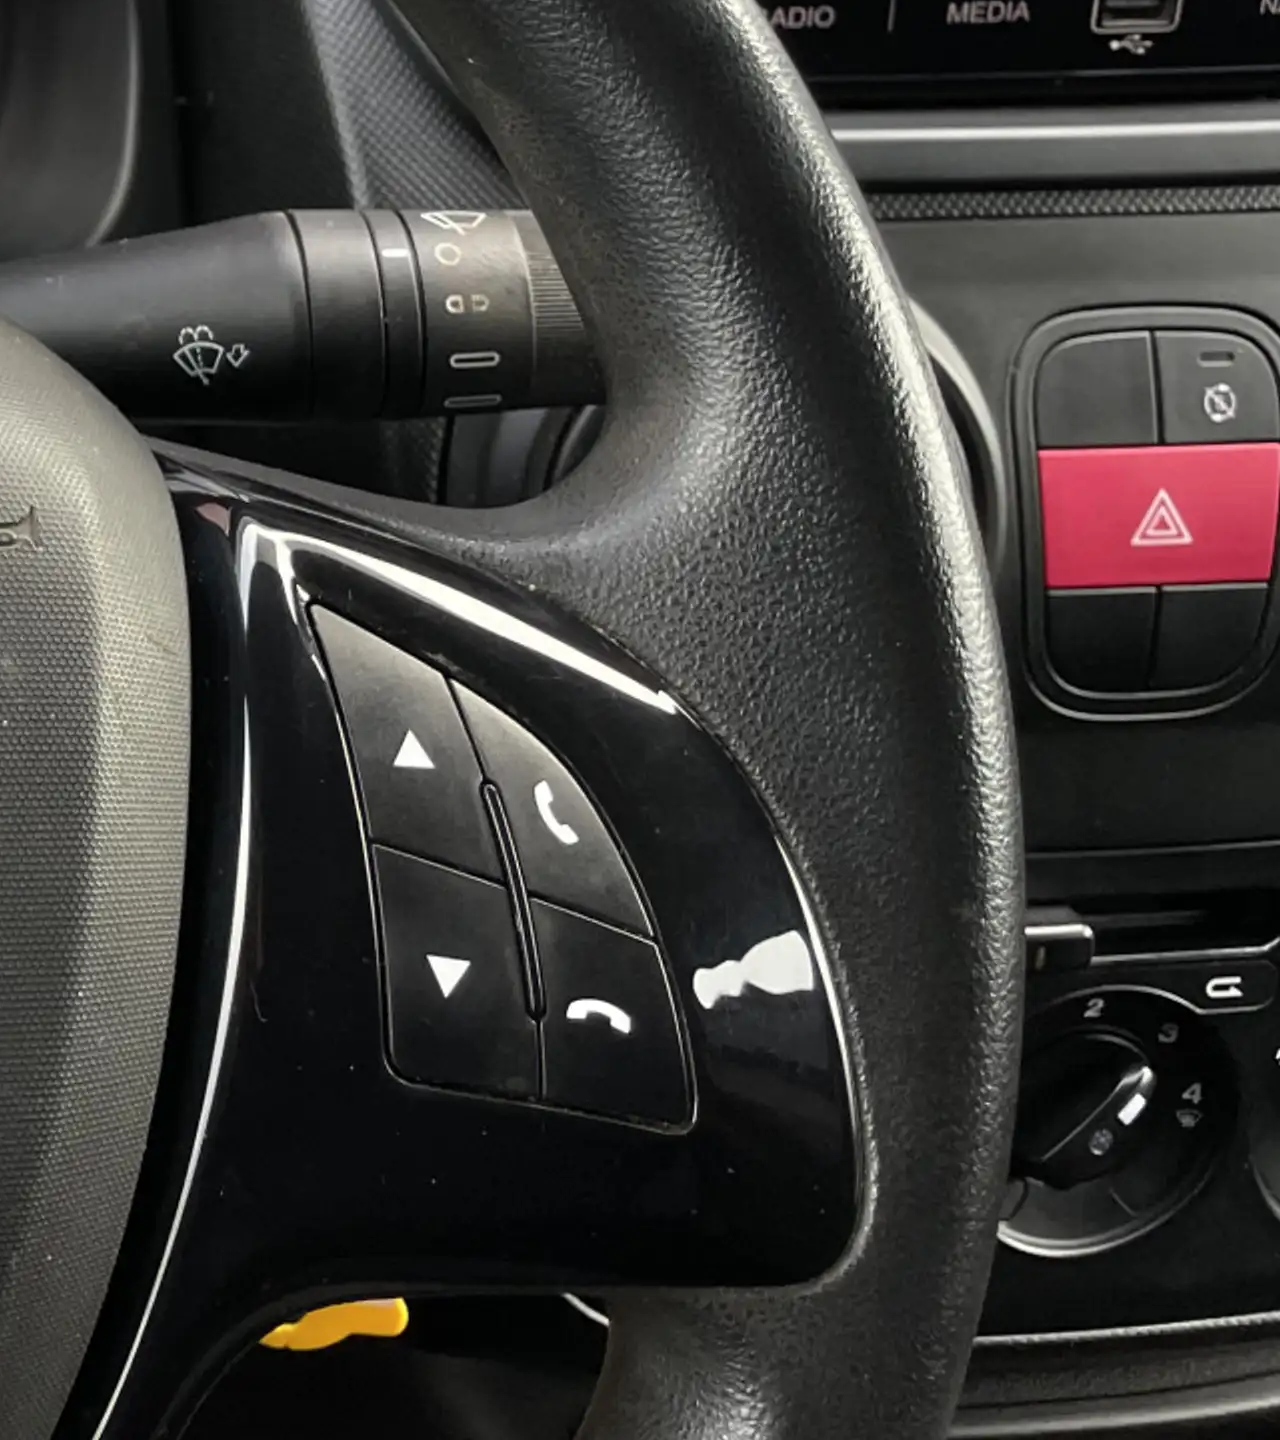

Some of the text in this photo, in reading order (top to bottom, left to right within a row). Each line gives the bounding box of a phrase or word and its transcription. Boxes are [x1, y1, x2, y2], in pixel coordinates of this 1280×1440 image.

[946, 1, 1031, 25] MEDIA
[1083, 998, 1106, 1018] 2
[1181, 1083, 1203, 1105] 4
